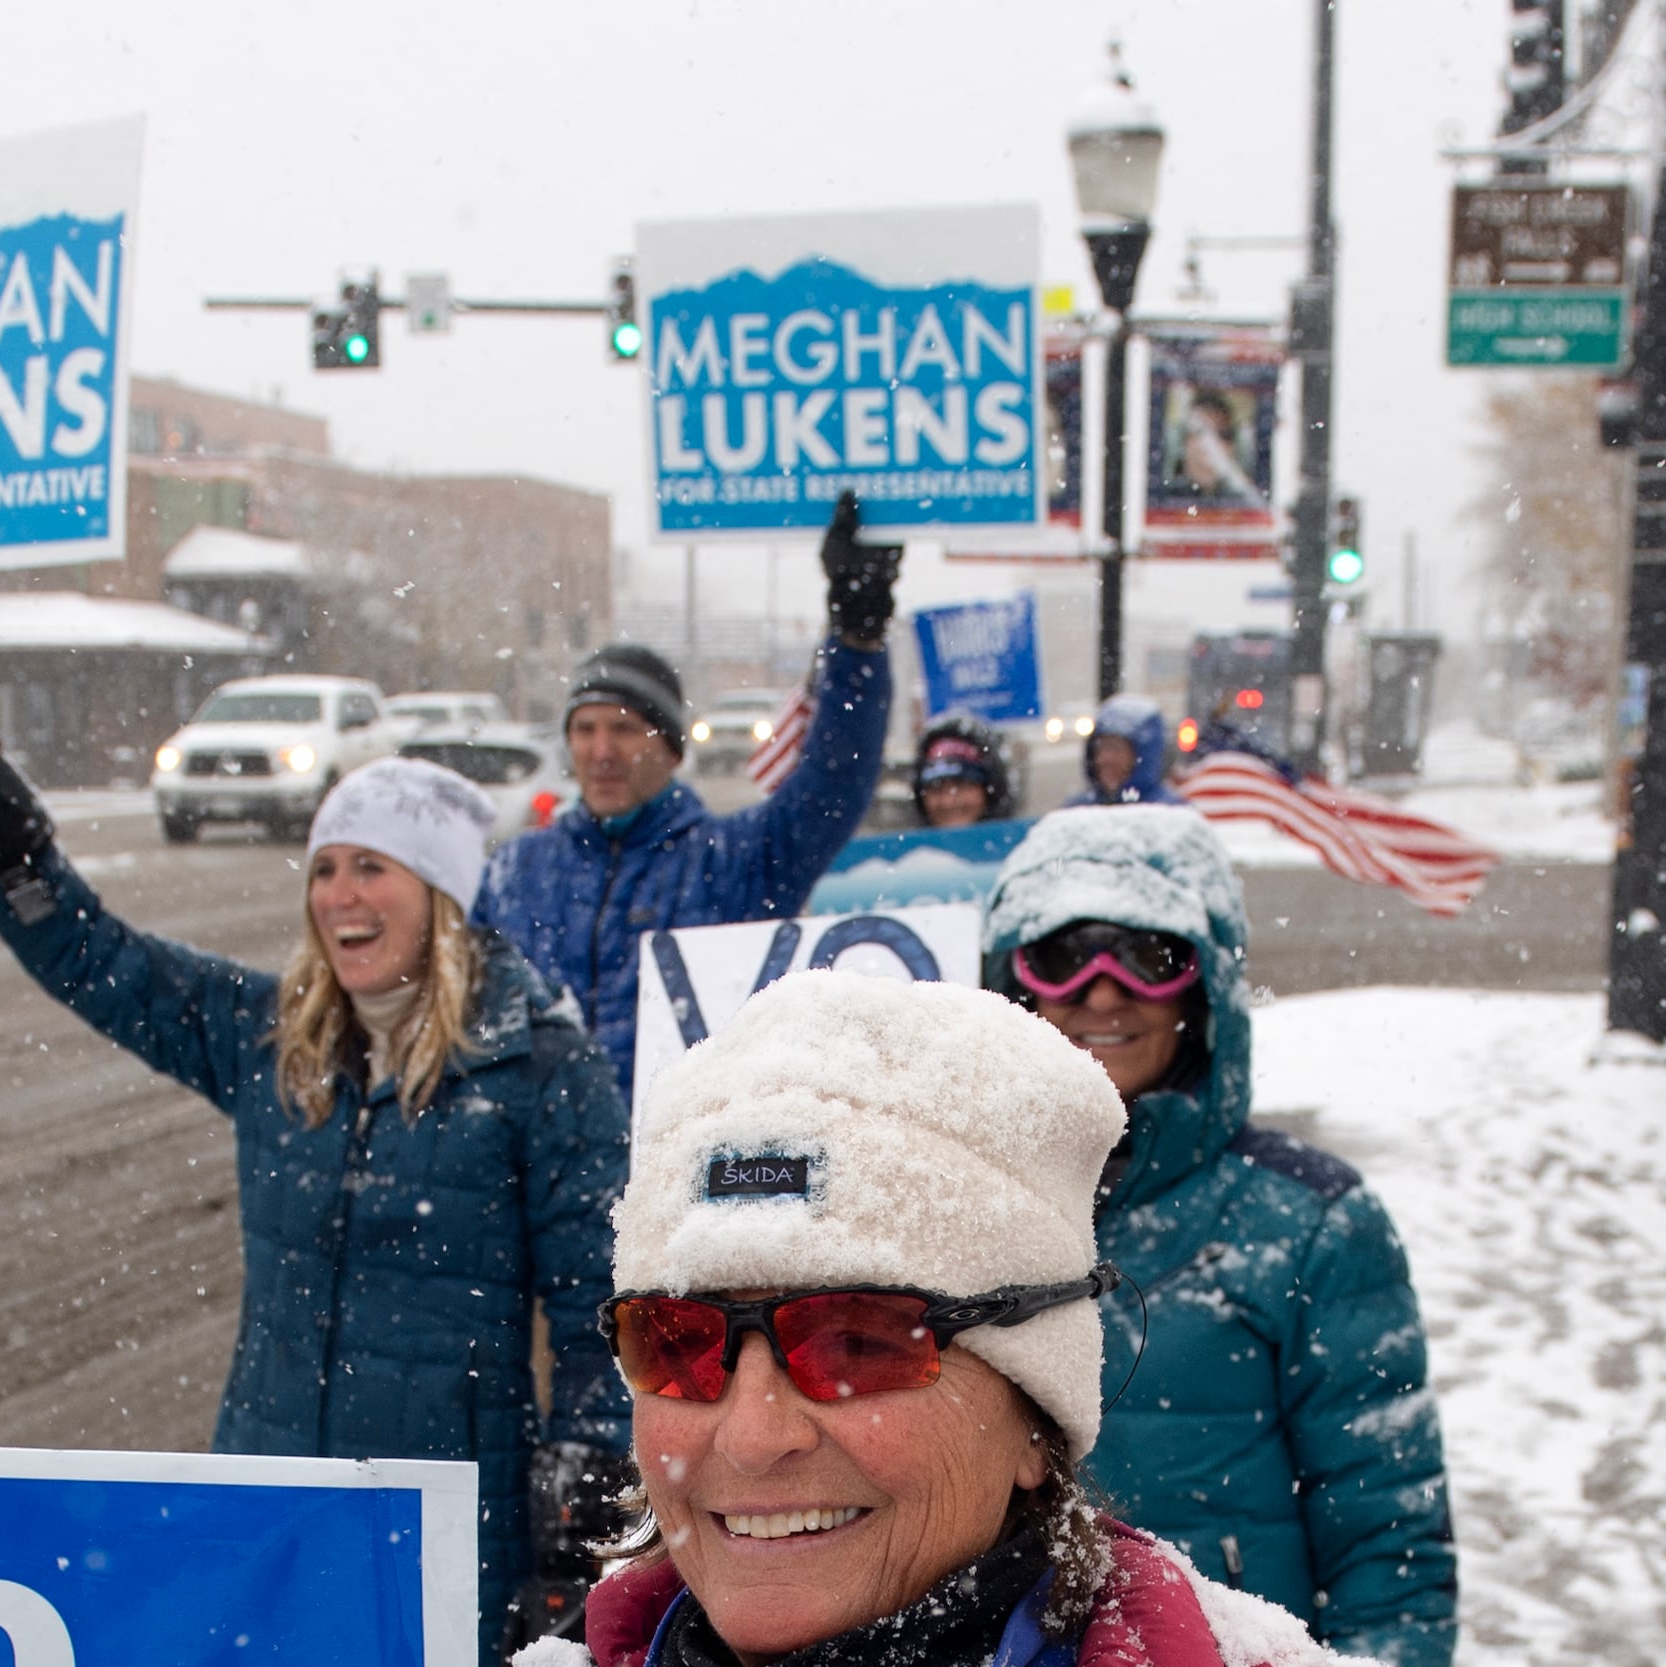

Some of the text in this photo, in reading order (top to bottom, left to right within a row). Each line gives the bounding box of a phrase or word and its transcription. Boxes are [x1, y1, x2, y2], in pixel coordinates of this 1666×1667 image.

[656, 302, 1025, 392] MEGHAN
[660, 383, 1030, 472] LUKENS
[660, 470, 1030, 506] FOR STATE REPRESENTATIVE
[721, 1166, 793, 1185] SKIDA
